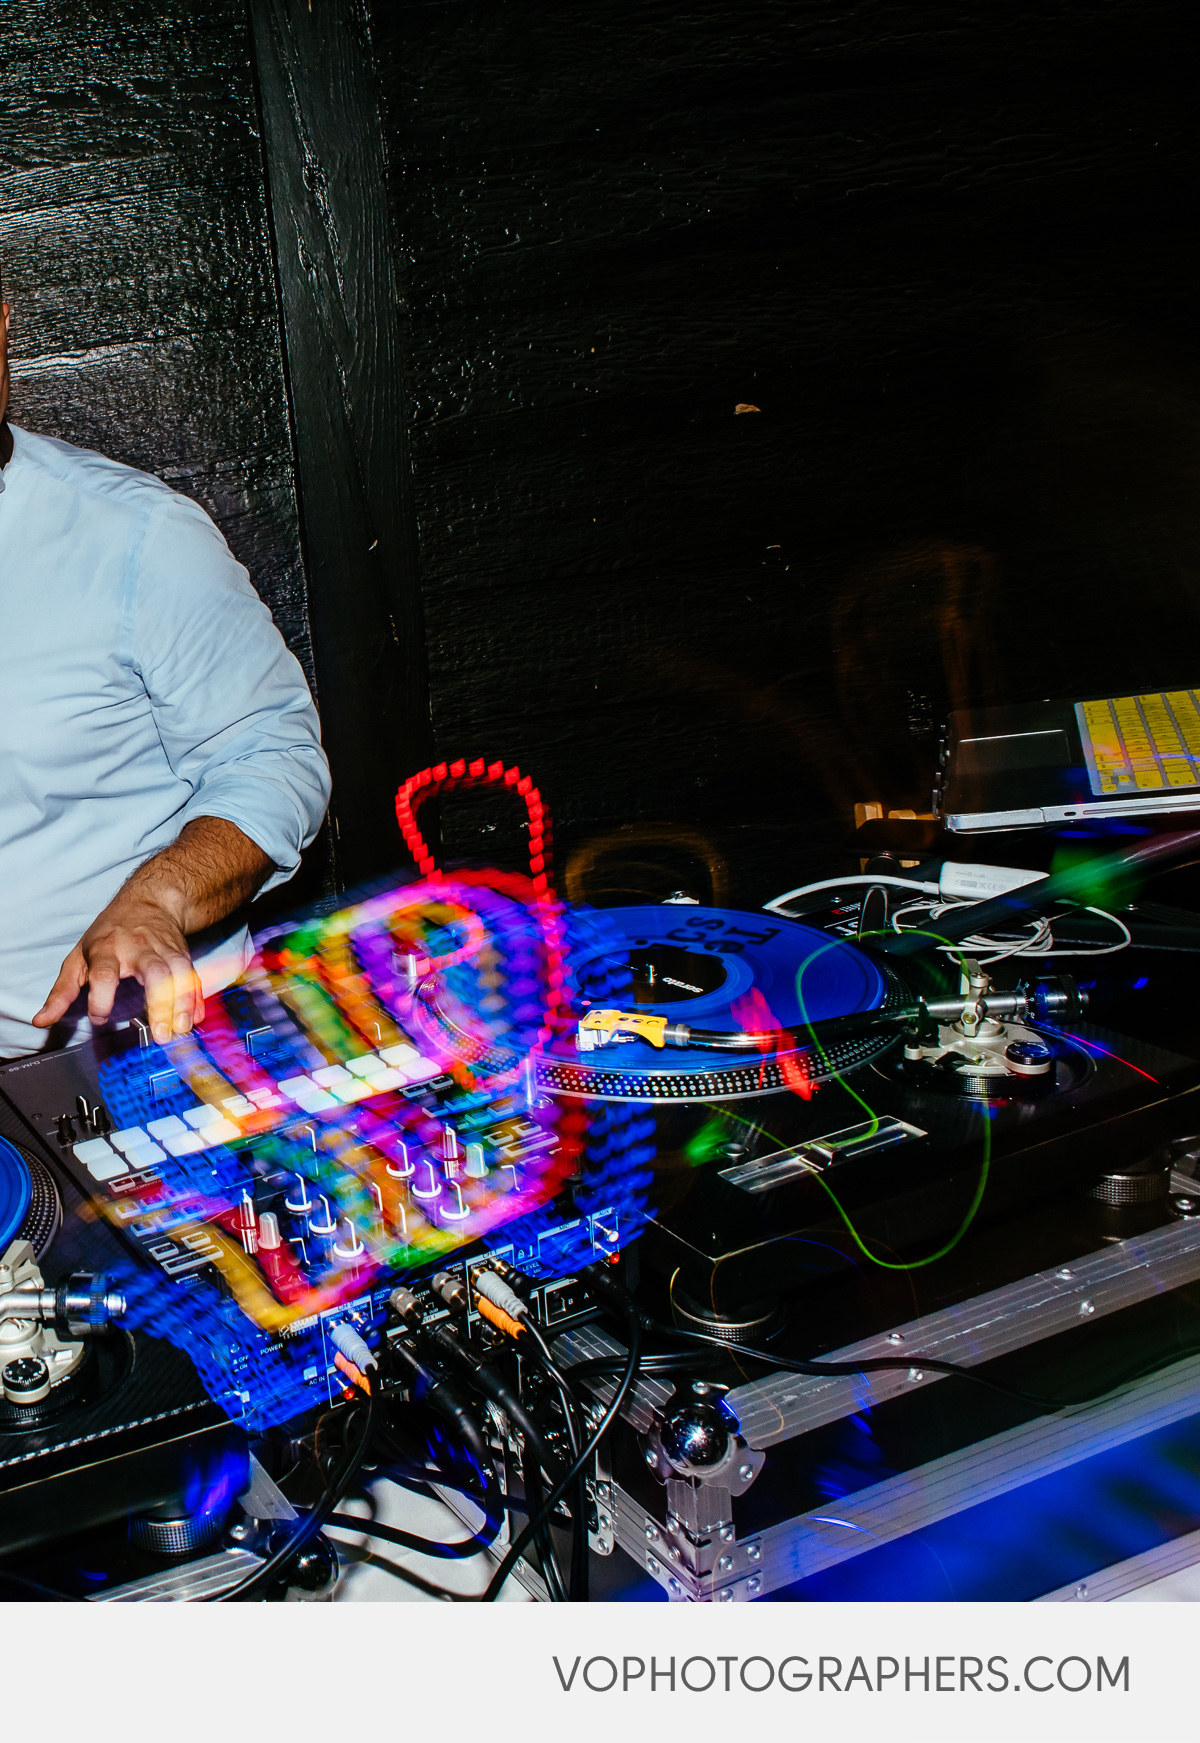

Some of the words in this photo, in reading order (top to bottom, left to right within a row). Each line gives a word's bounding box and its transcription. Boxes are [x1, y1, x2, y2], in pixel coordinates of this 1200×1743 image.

[662, 976, 704, 994] serato
[522, 1262, 540, 1272] LEVEL
[260, 1342, 284, 1355] POWER
[238, 1355, 249, 1363] OFF
[239, 1363, 248, 1371] ON
[308, 1378, 318, 1386] AC
